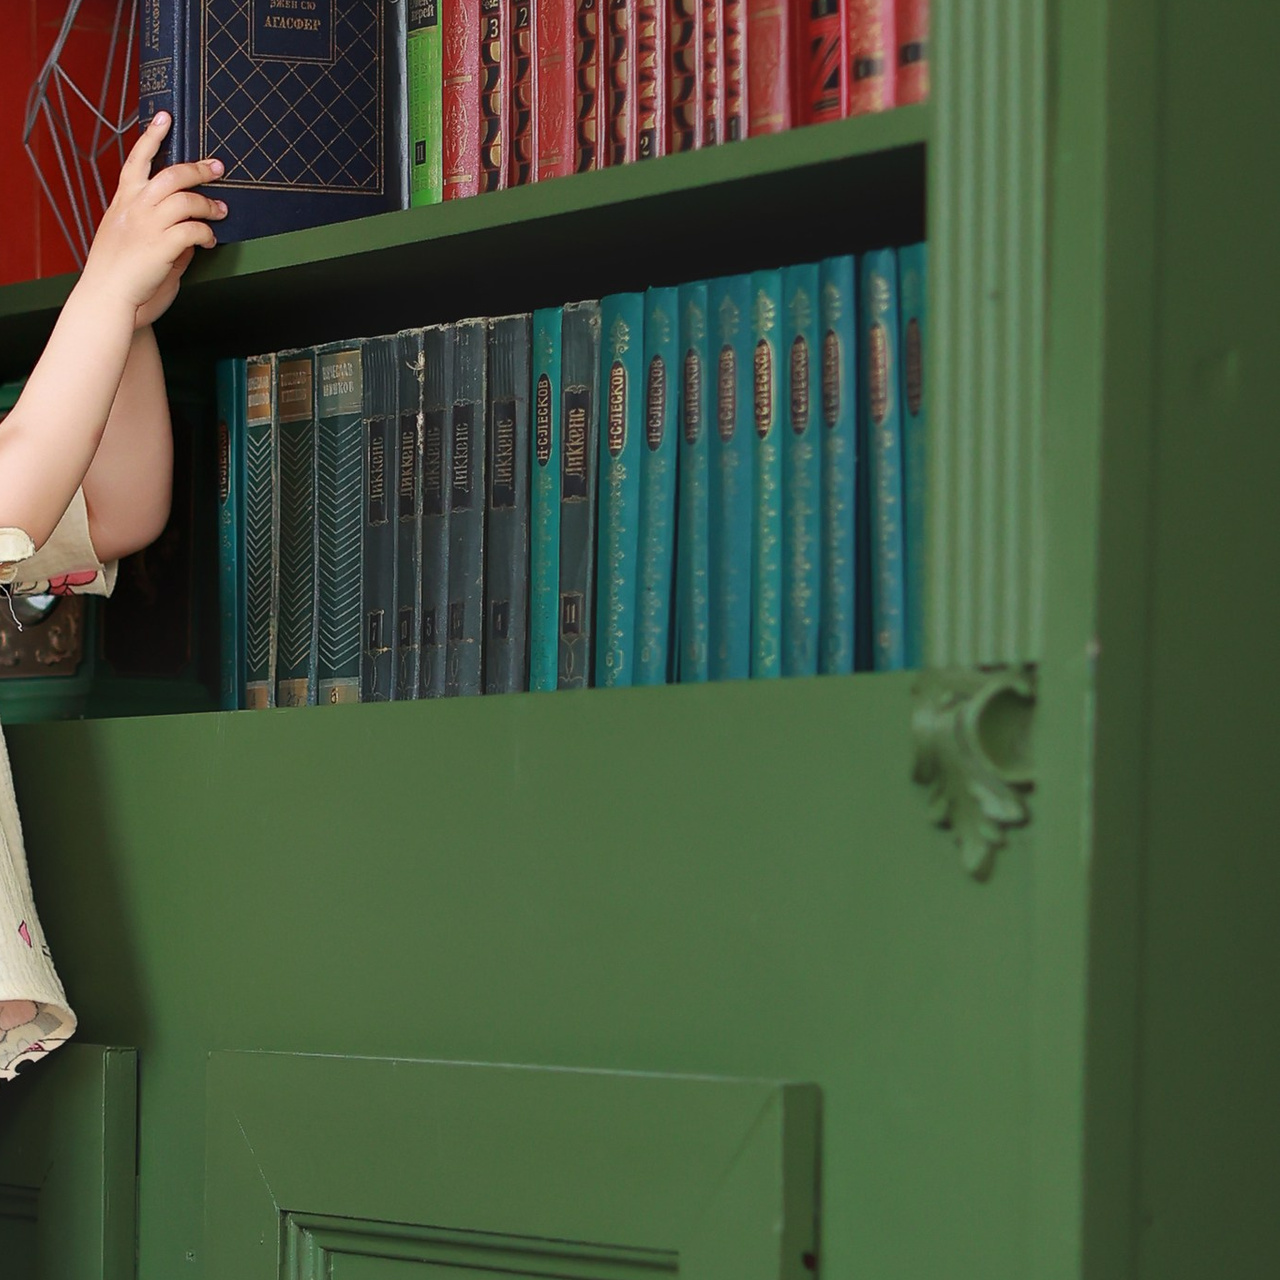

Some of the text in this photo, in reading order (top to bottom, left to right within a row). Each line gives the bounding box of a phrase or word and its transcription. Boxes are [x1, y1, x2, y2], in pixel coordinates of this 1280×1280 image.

[264, 15, 321, 31] АГАСФЕР
[300, 1, 317, 11] СЮ
[490, 18, 499, 39] 3
[519, 7, 529, 28] 2
[640, 136, 650, 154] 2
[400, 431, 415, 501] Диккенс
[453, 422, 469, 493] Диккенс
[494, 418, 514, 491] Диккенс
[565, 407, 585, 482] Диккенс
[371, 436, 384, 505] Диккенс
